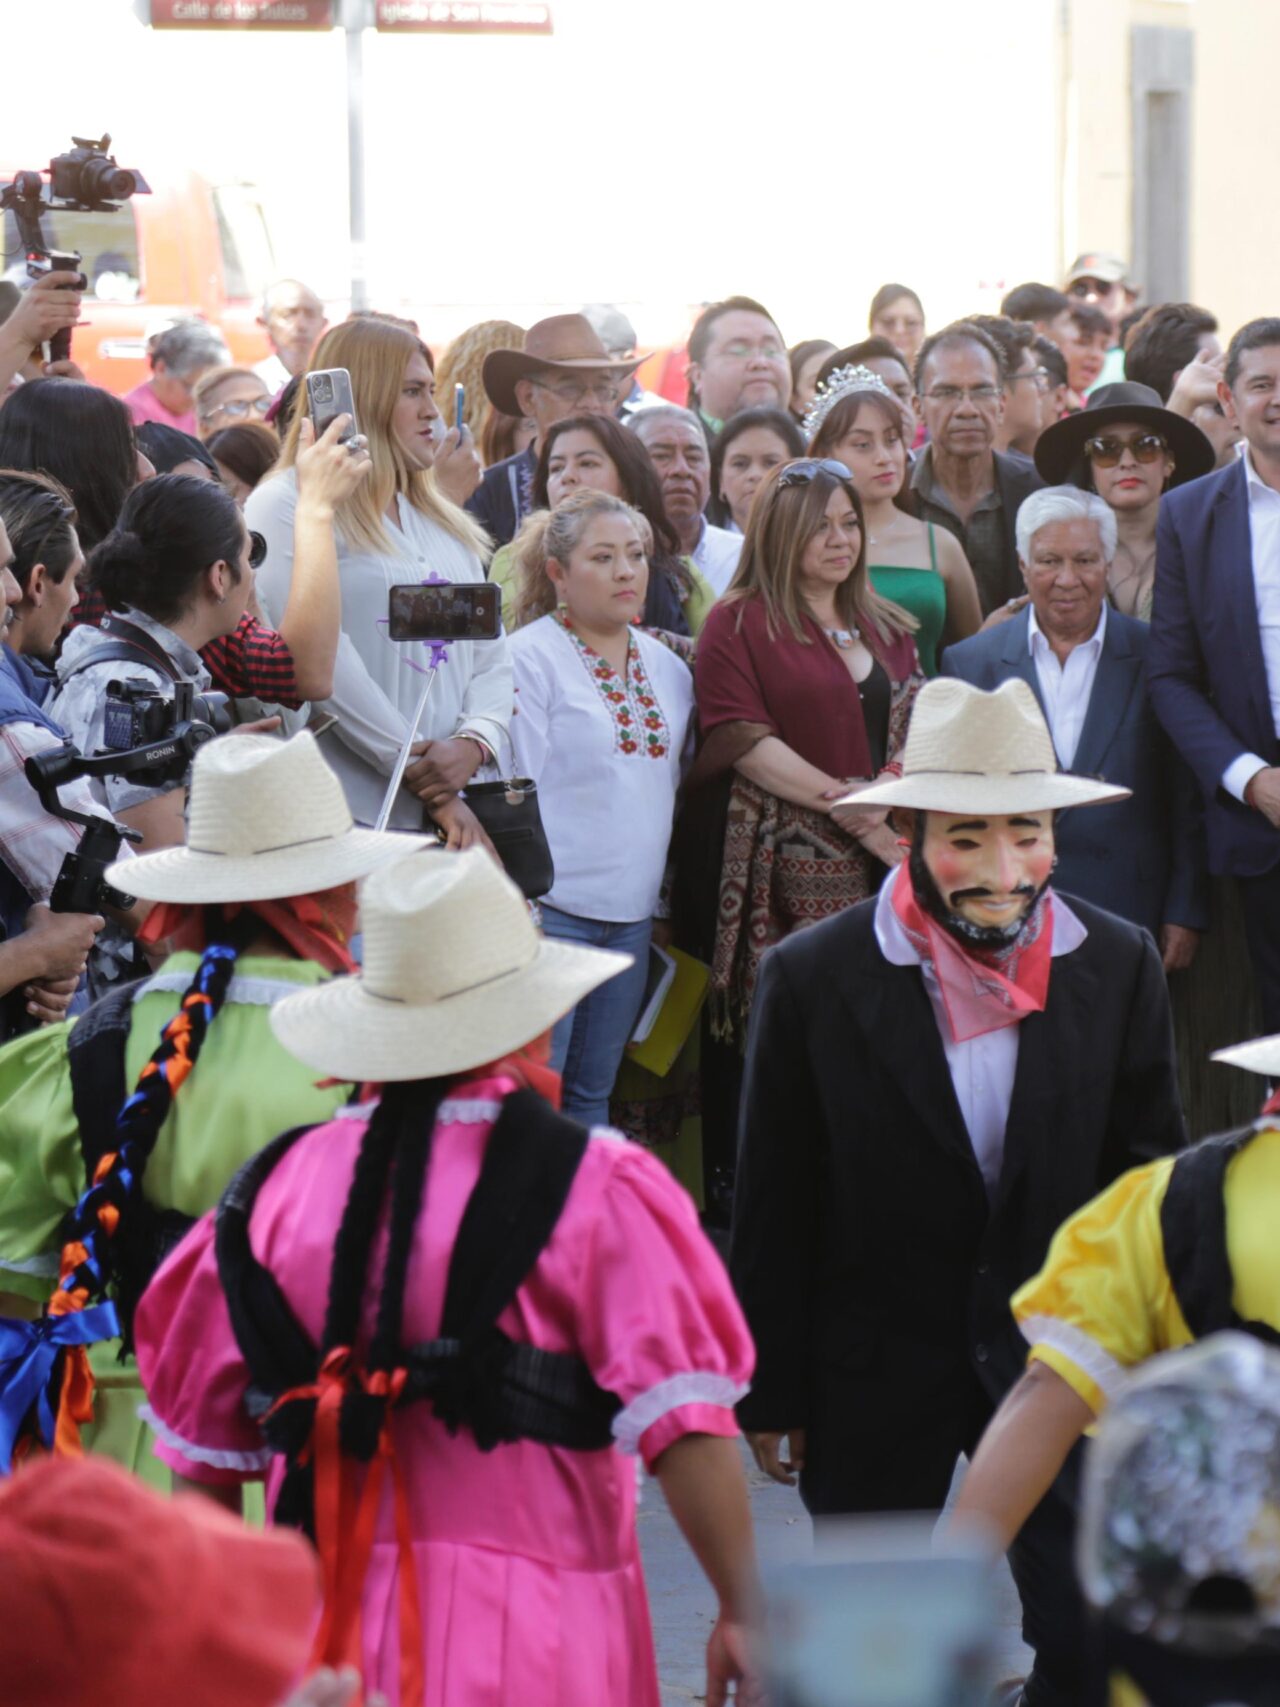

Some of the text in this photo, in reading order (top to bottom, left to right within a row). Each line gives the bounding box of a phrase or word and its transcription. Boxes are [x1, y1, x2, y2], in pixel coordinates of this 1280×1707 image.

[172, 1, 210, 19] Calle
[211, 2, 233, 19] de
[234, 1, 258, 20] los
[381, 3, 428, 24] Iglesia
[429, 3, 450, 21] de
[451, 4, 480, 21] San
[145, 745, 176, 761] RONIN
